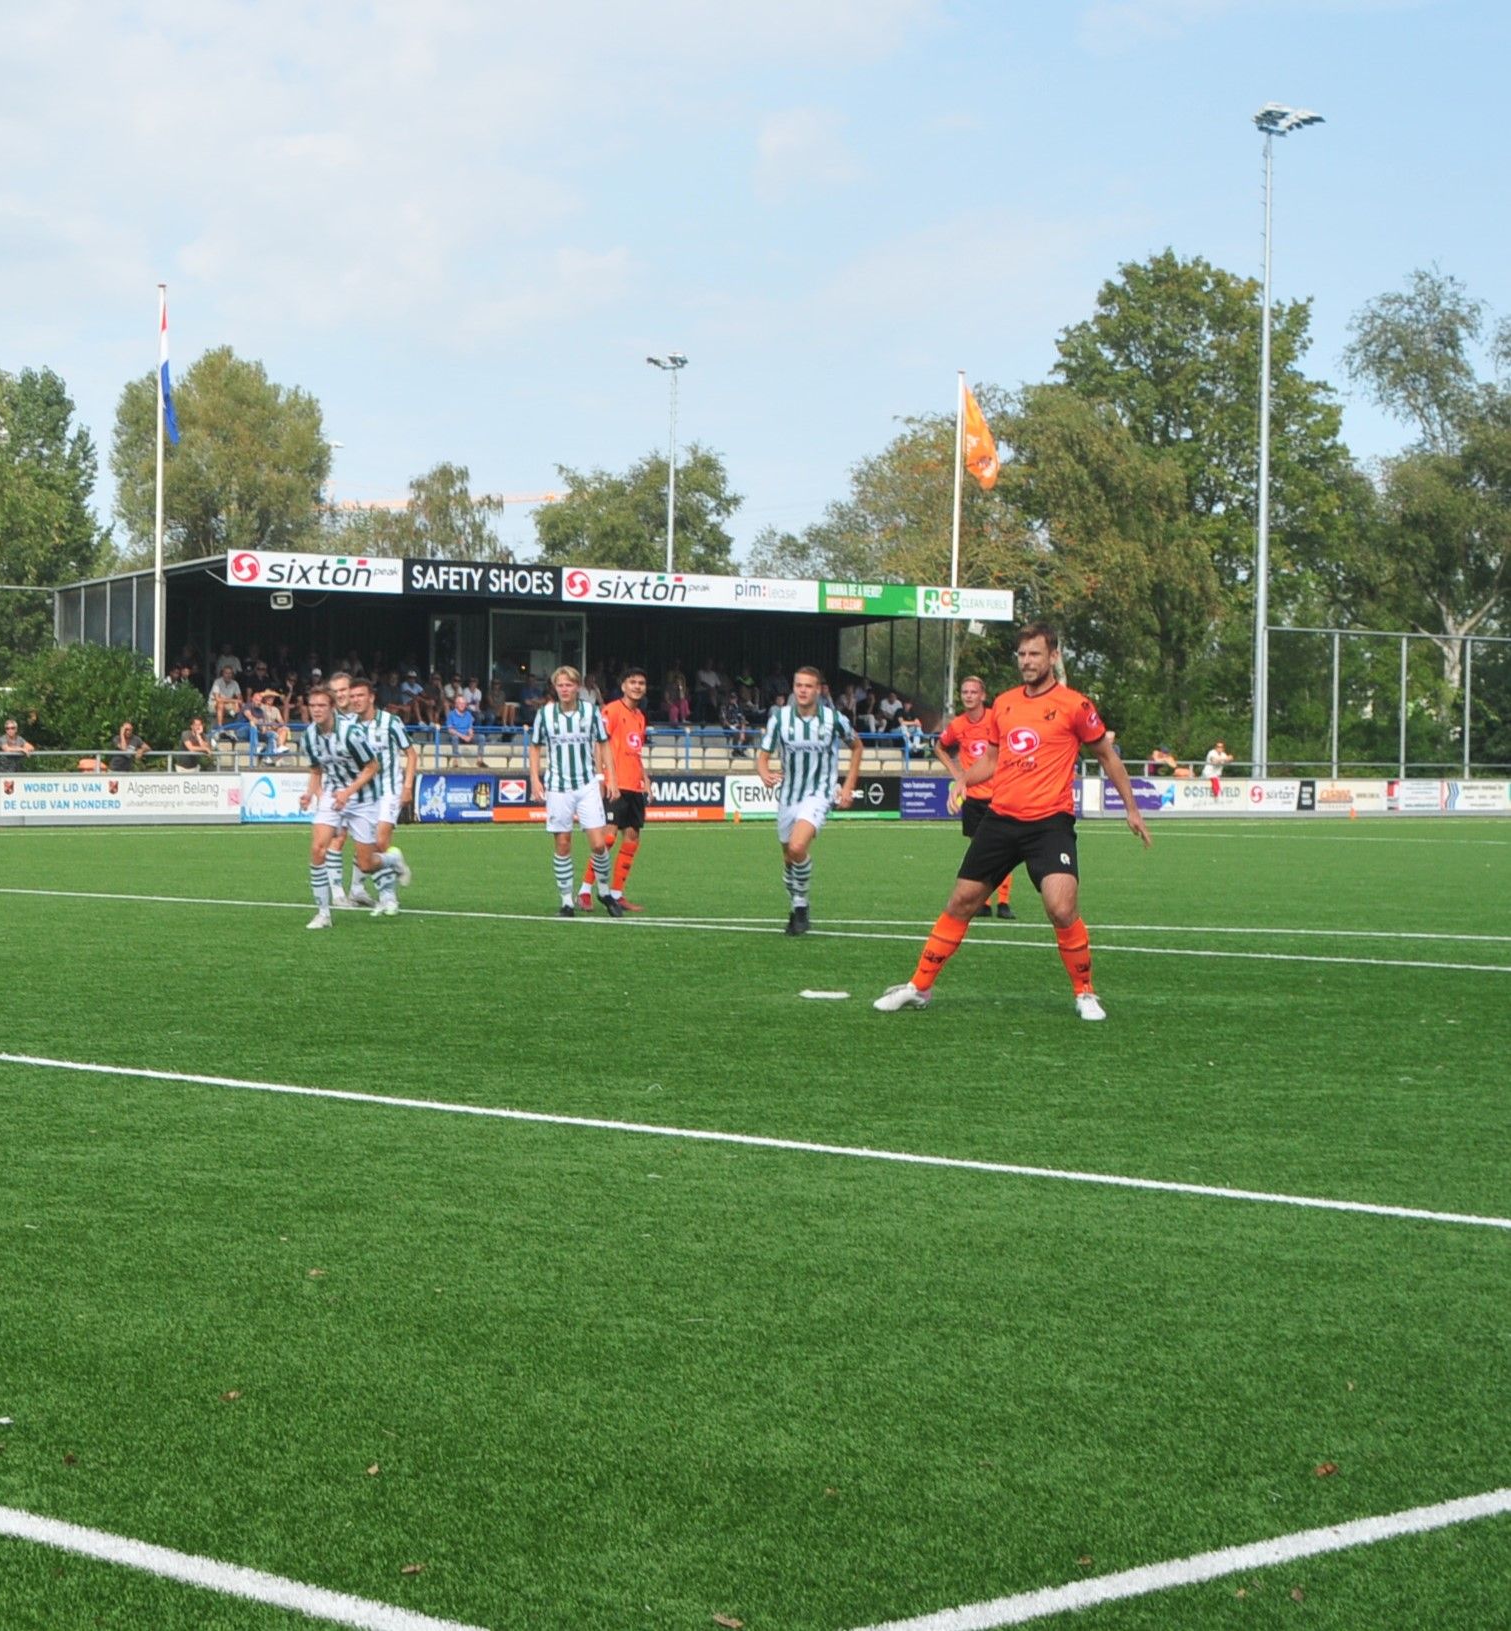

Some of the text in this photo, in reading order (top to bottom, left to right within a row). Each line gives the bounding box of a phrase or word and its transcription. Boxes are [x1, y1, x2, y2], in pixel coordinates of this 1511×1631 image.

[267, 558, 372, 587] sixton
[411, 564, 555, 595] SAFETY SHOES
[595, 575, 687, 602] sixton
[23, 783, 102, 793] WORDT LID VAN
[127, 780, 219, 798] Algemeen Belang
[651, 781, 721, 802] AMASUS
[737, 785, 782, 802] TERWO
[1183, 786, 1240, 798] OOSTEVELD
[3, 799, 121, 810] DE CLUB VAN HONDERD
